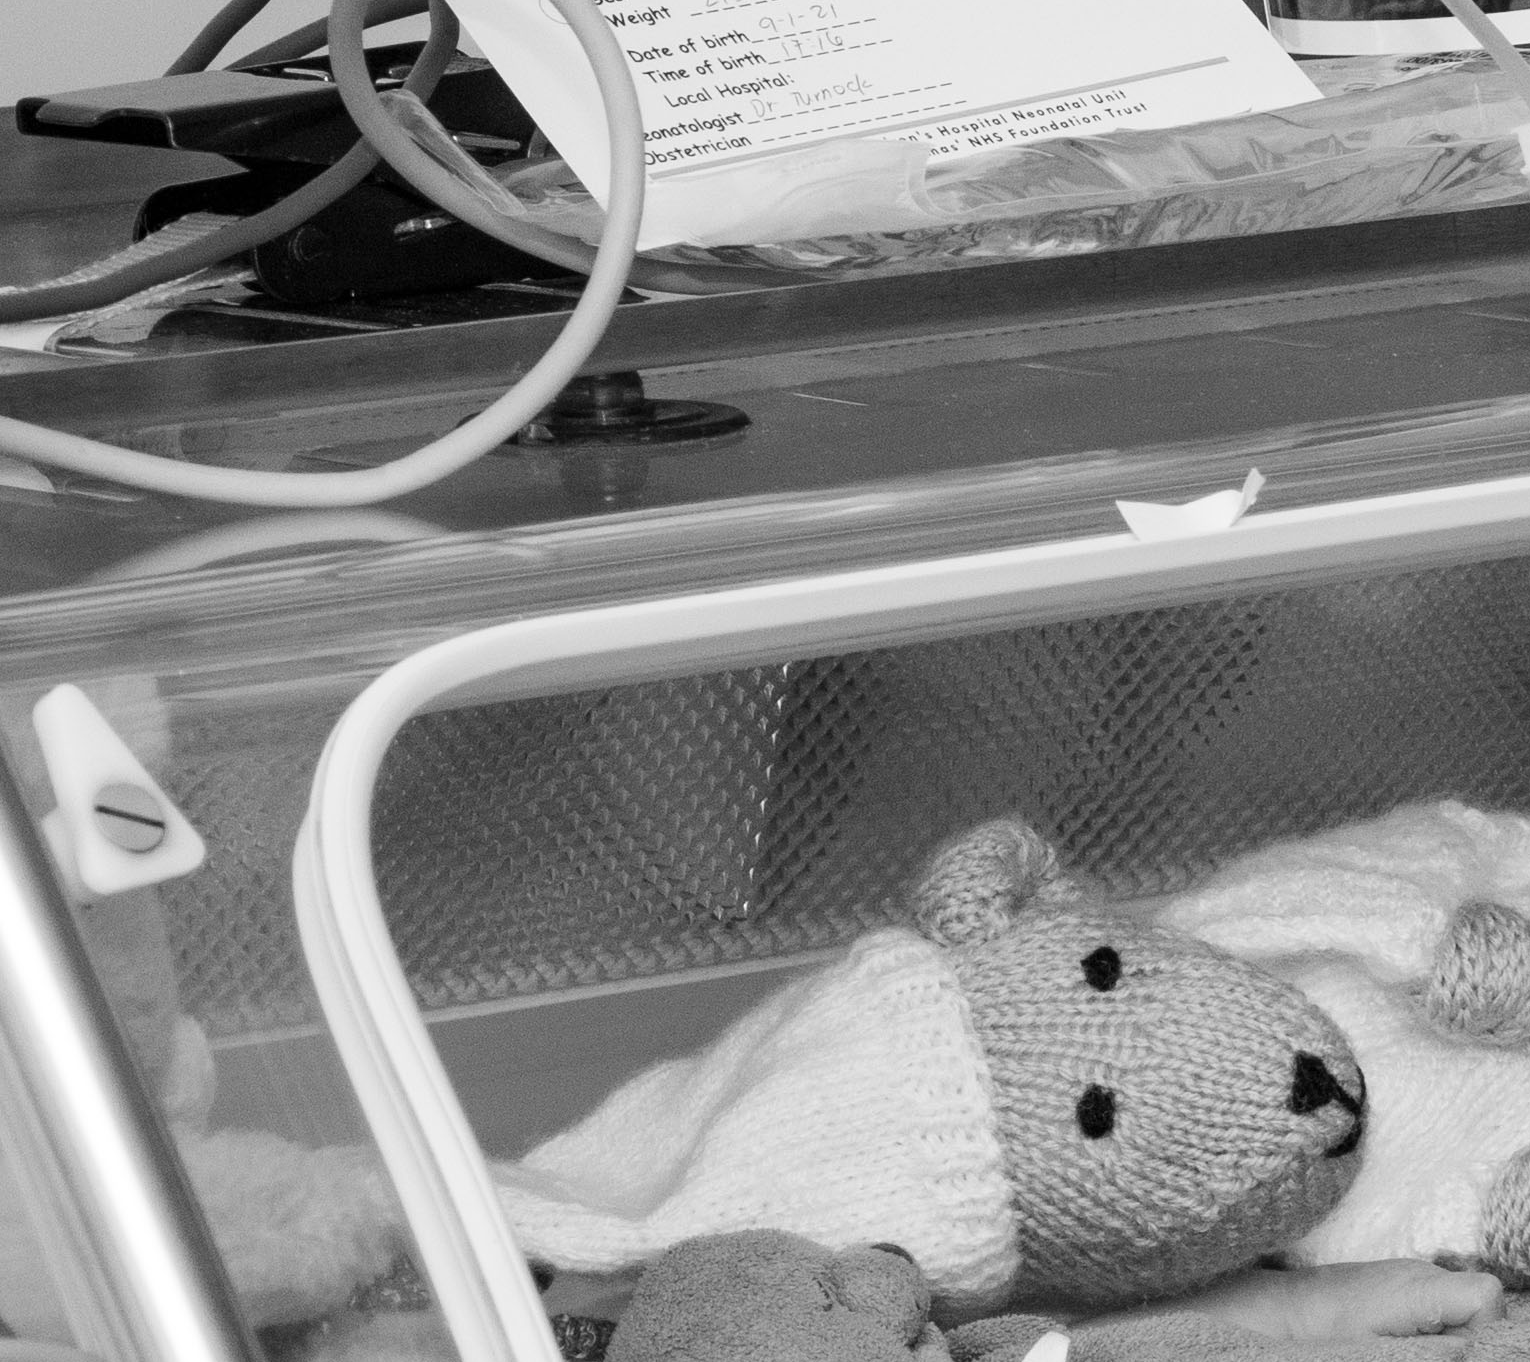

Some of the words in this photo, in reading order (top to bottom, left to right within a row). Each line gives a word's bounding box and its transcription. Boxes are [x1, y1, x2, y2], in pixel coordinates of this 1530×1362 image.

[604, 5, 671, 29] Weight
[627, 45, 673, 64] Date
[679, 38, 697, 54] of
[700, 29, 751, 50] birth
[642, 66, 690, 85] Time
[695, 60, 713, 75] of
[717, 51, 767, 72] birth
[664, 87, 712, 108] Local
[719, 72, 796, 101] Hospital:
[644, 110, 744, 144] eonatologist
[936, 114, 1008, 137] Hospital
[1012, 97, 1087, 121] Neonatal
[1091, 88, 1127, 105] Unit
[968, 126, 1003, 148] NHS
[1008, 109, 1102, 139] Foundation
[1105, 102, 1148, 118] Trust
[644, 134, 752, 166] Obstetrician
